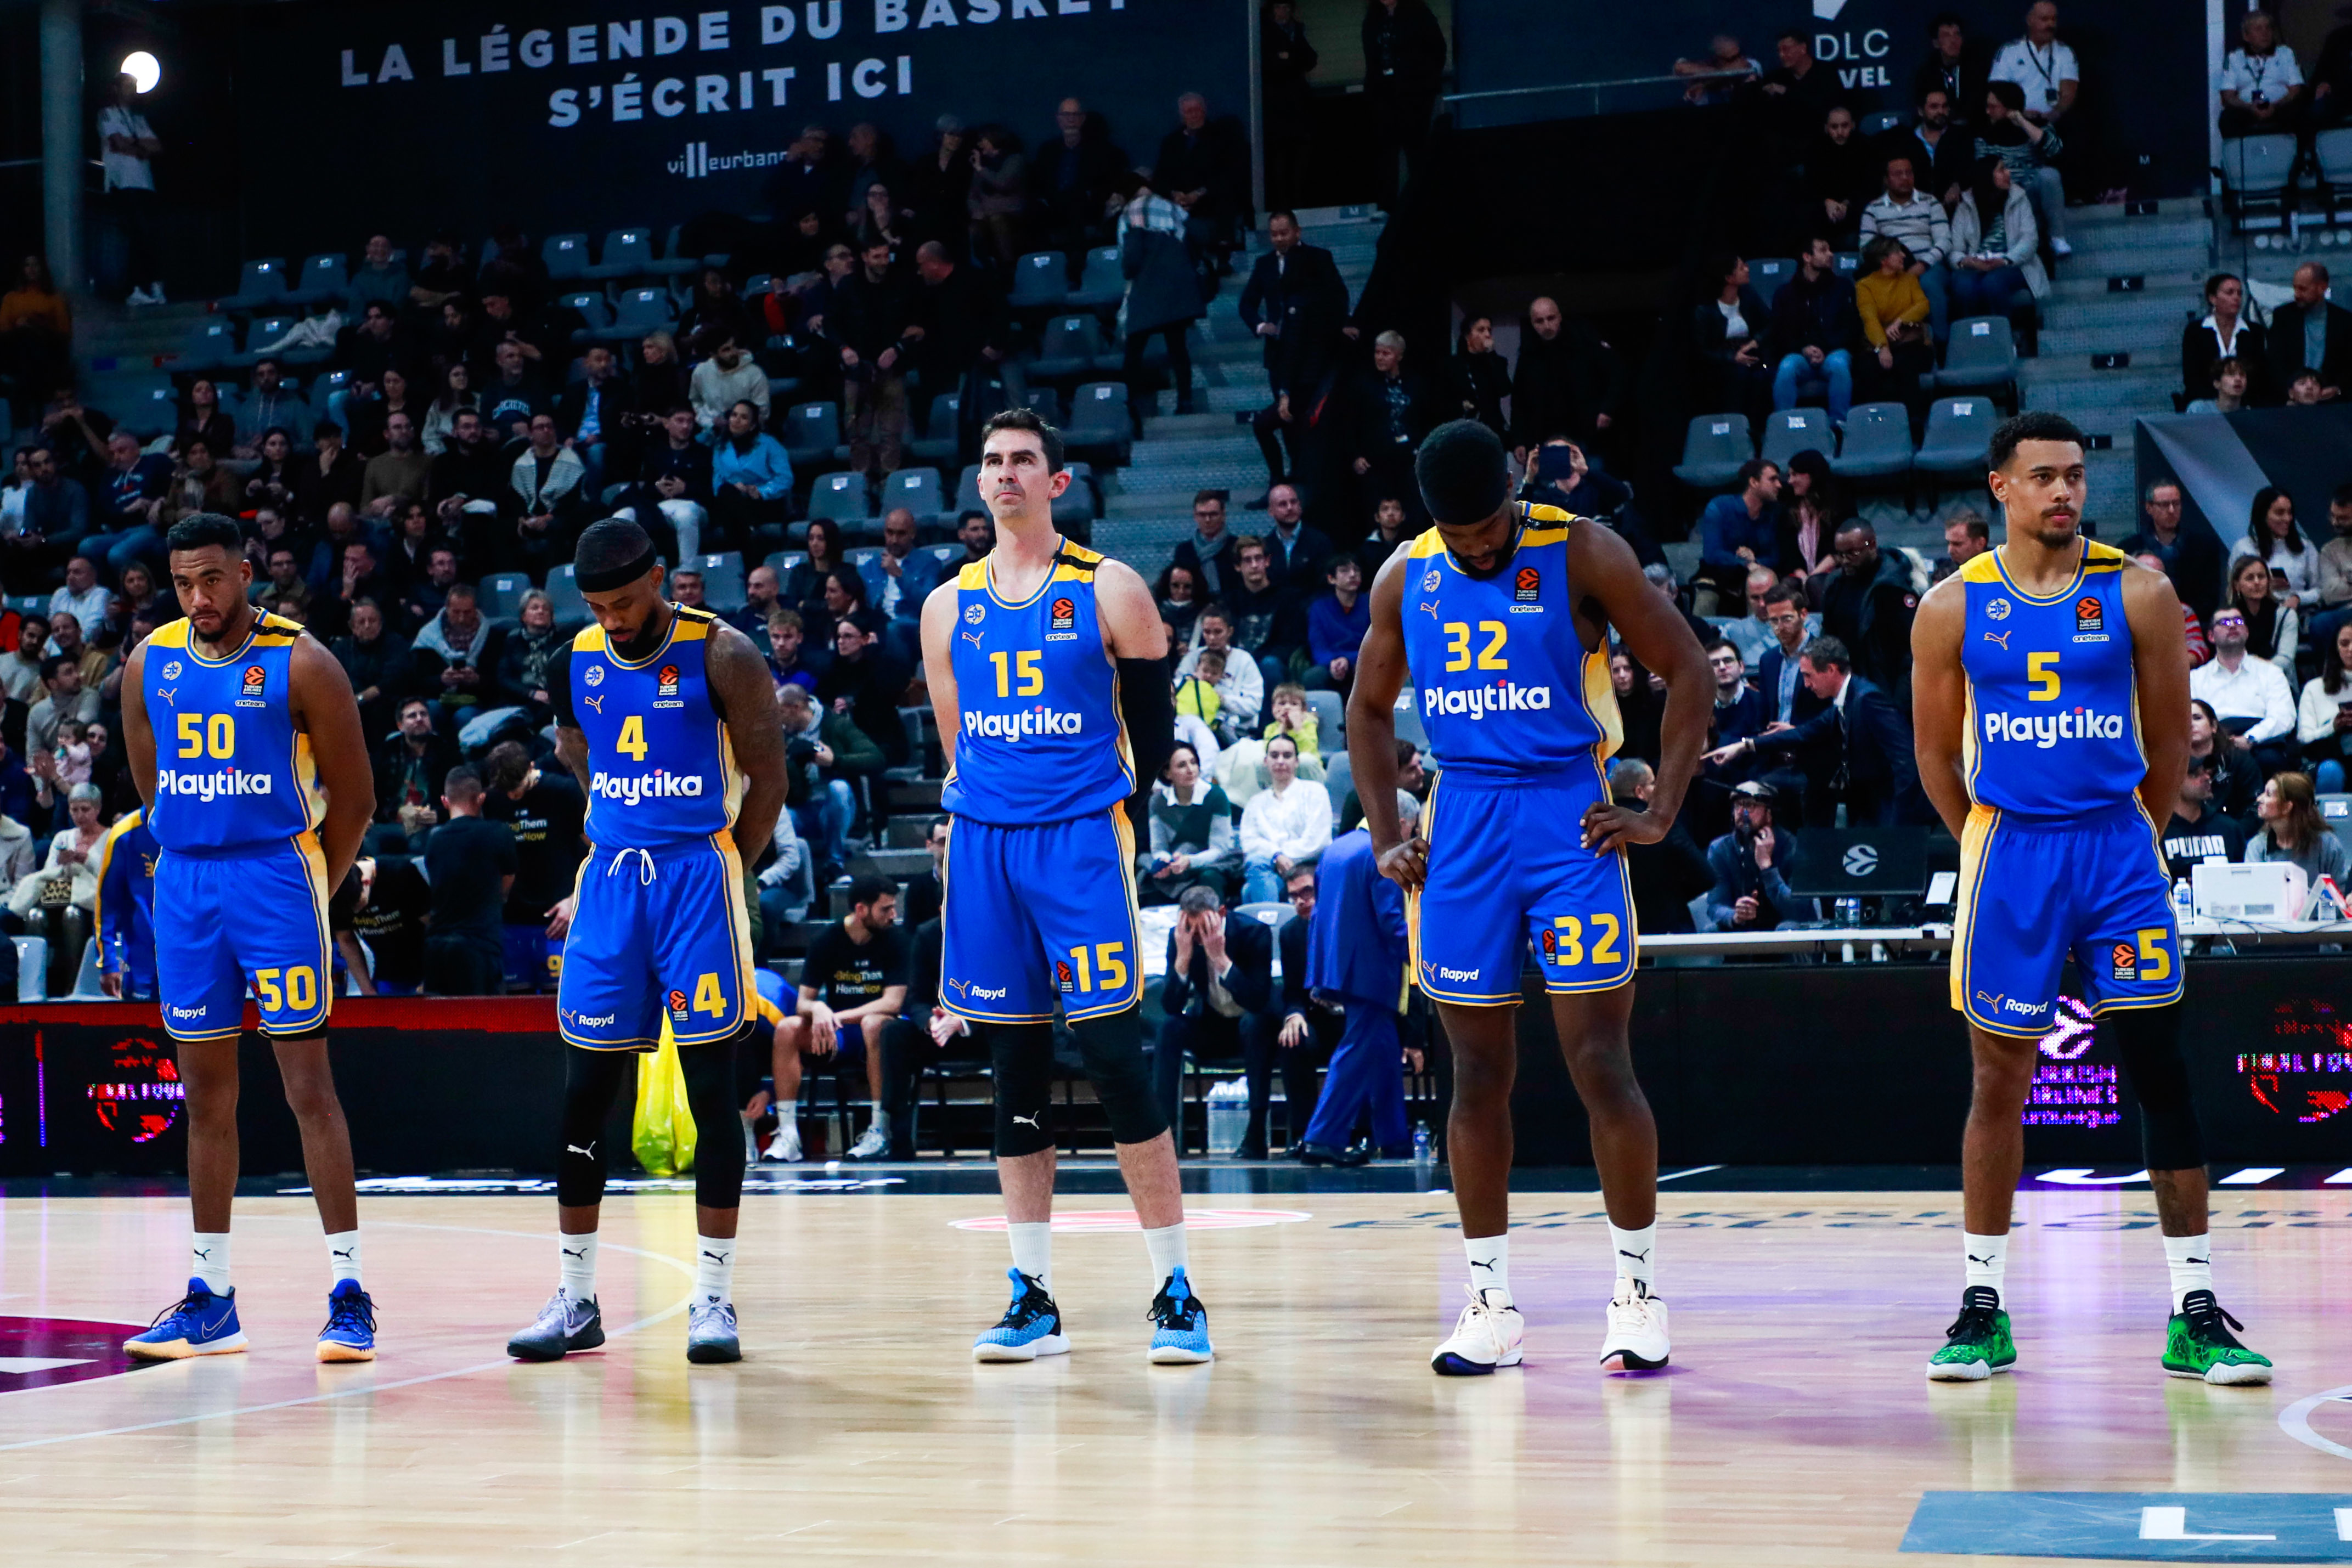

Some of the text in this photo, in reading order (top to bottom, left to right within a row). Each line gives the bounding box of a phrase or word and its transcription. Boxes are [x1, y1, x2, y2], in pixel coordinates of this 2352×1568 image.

[341, 43, 413, 86] LA
[443, 10, 730, 76] LÉGENDE
[760, 0, 842, 46] DU
[1814, 28, 1890, 62] DLC
[827, 55, 912, 101] ICI
[1837, 66, 1892, 91] VEL
[667, 142, 787, 178] villeurbann
[2121, 278, 2130, 290] K
[2107, 355, 2114, 366] J
[1443, 621, 1509, 672] 32
[2073, 634, 2109, 642] oneteam
[989, 650, 1044, 698] 15
[2027, 651, 2061, 702] 5
[235, 700, 266, 708] oneteam
[653, 700, 684, 708] oneteam
[1424, 679, 1550, 720] Playtika
[177, 713, 235, 759] 50
[616, 715, 648, 762] 4
[964, 705, 1082, 743] Playtika
[1985, 706, 2123, 749] Playtika
[159, 766, 272, 803] Playtika
[591, 768, 703, 806] Playtika
[2164, 835, 2226, 860] PUMA
[1554, 912, 1622, 967] 32
[2137, 928, 2171, 981] 5
[1069, 941, 1127, 993] 15
[1440, 966, 1480, 983] Rapyd
[255, 965, 317, 1013] 50
[692, 972, 727, 1019] 4
[971, 984, 1006, 1001] Rapyd
[2004, 997, 2049, 1016] Rapyd
[172, 1005, 206, 1020] Rapyd
[578, 1013, 615, 1028] Rapyd
